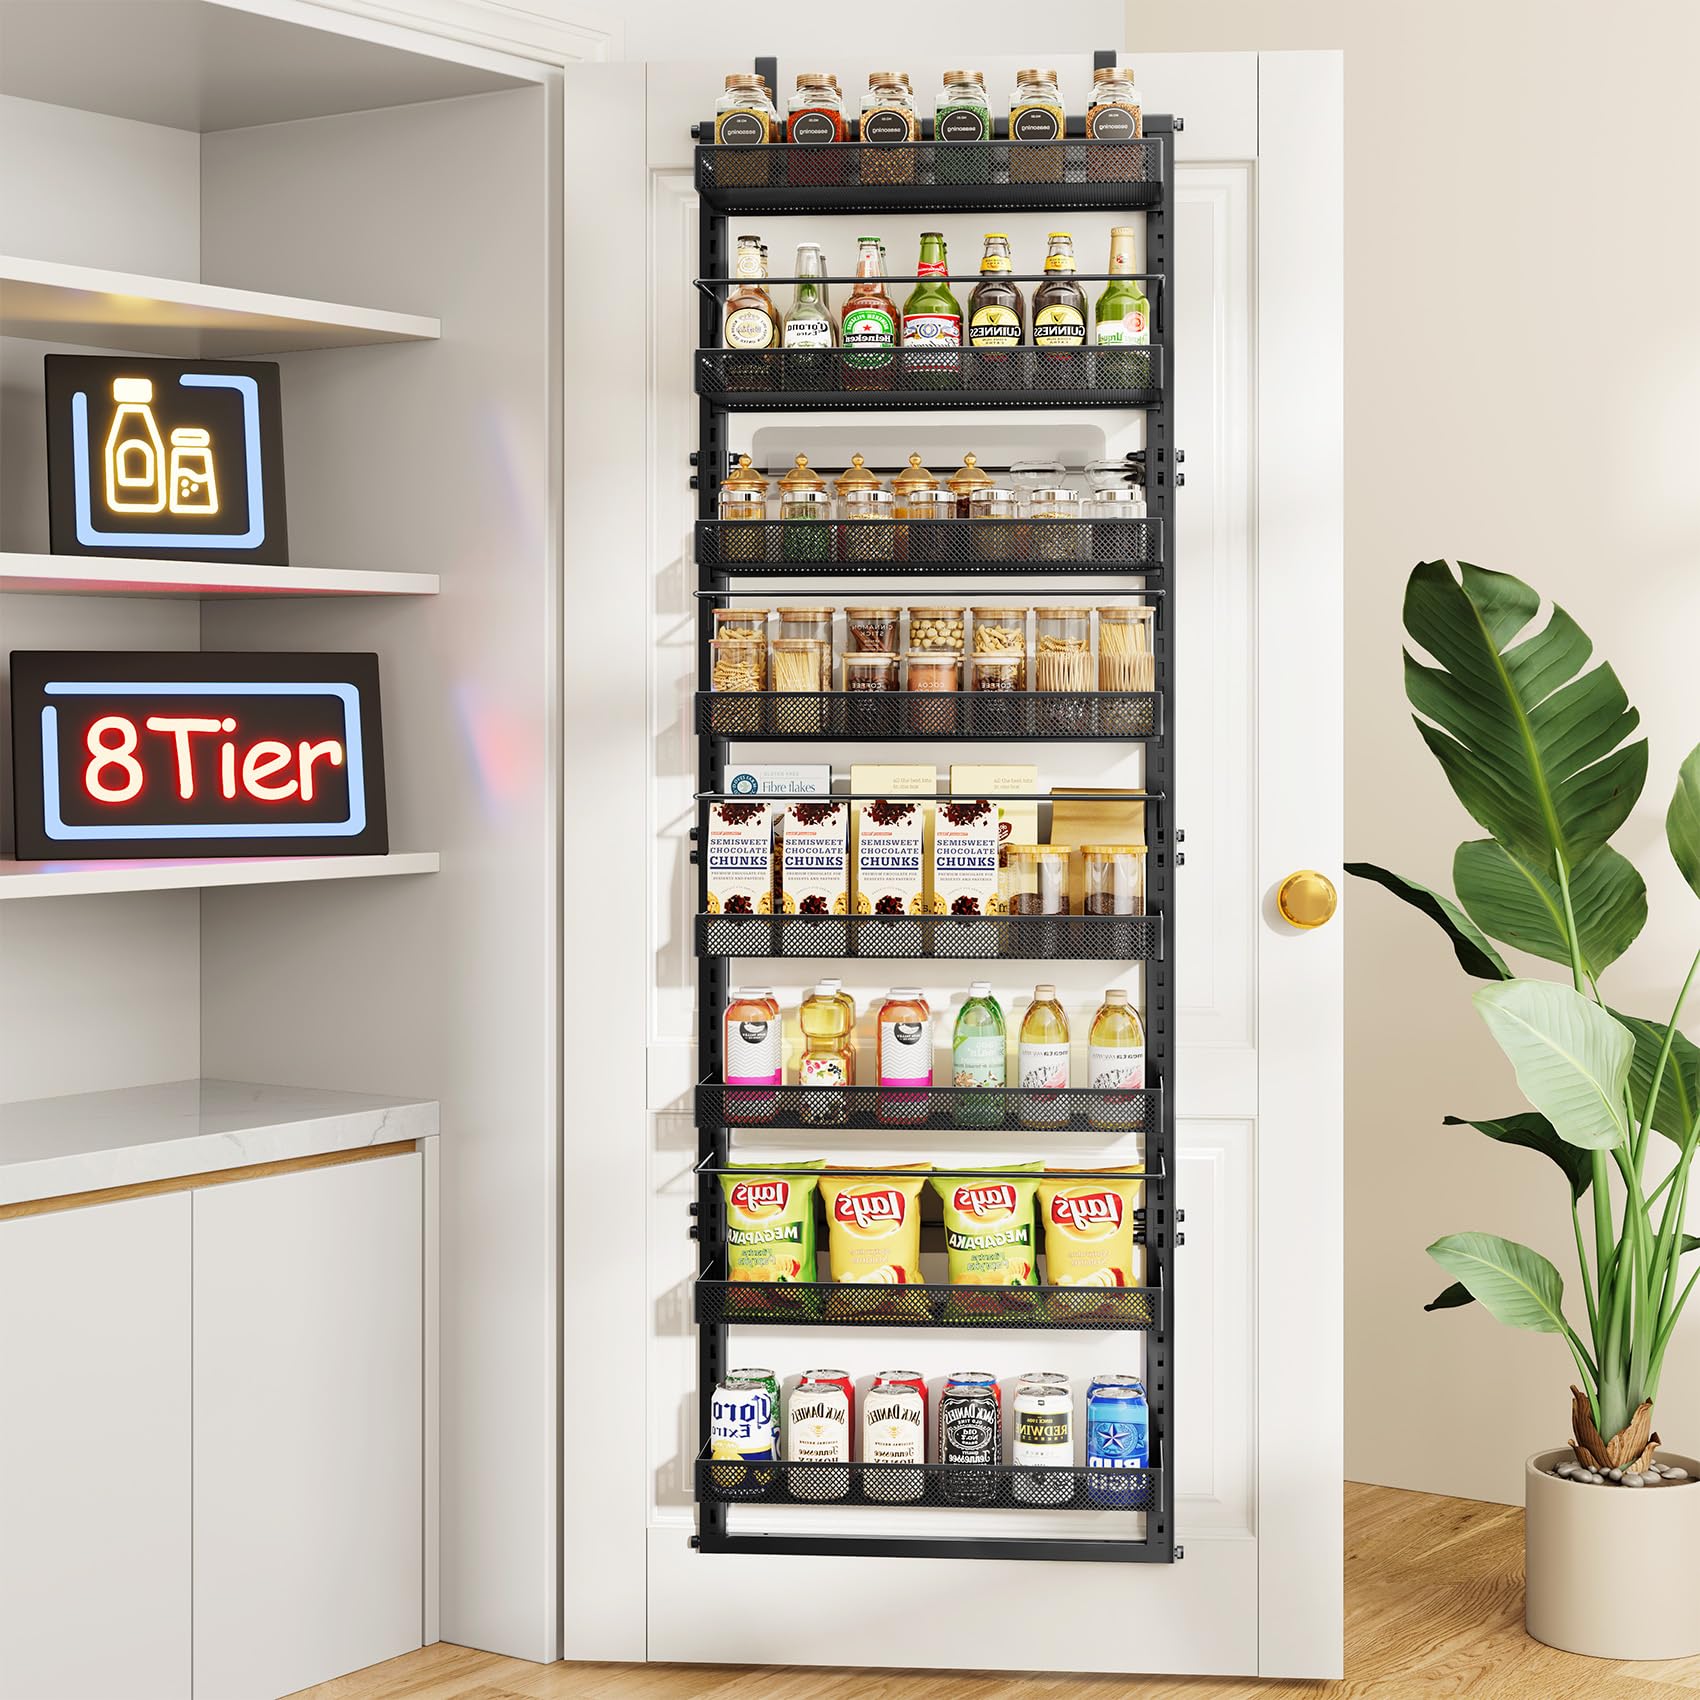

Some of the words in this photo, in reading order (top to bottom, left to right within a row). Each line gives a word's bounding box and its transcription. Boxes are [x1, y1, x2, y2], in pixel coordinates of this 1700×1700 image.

[762, 781, 787, 793] Fibre
[788, 780, 816, 793] flakes
[785, 847, 844, 855] CHOCOLATE
[861, 847, 919, 855] CHOCOLATE
[936, 847, 995, 855] CHOCOLATE
[710, 856, 767, 866] CHUNKS
[785, 856, 843, 866] CHUNKS
[861, 856, 919, 866] CHUNKS
[936, 856, 995, 867] CHUNKS
